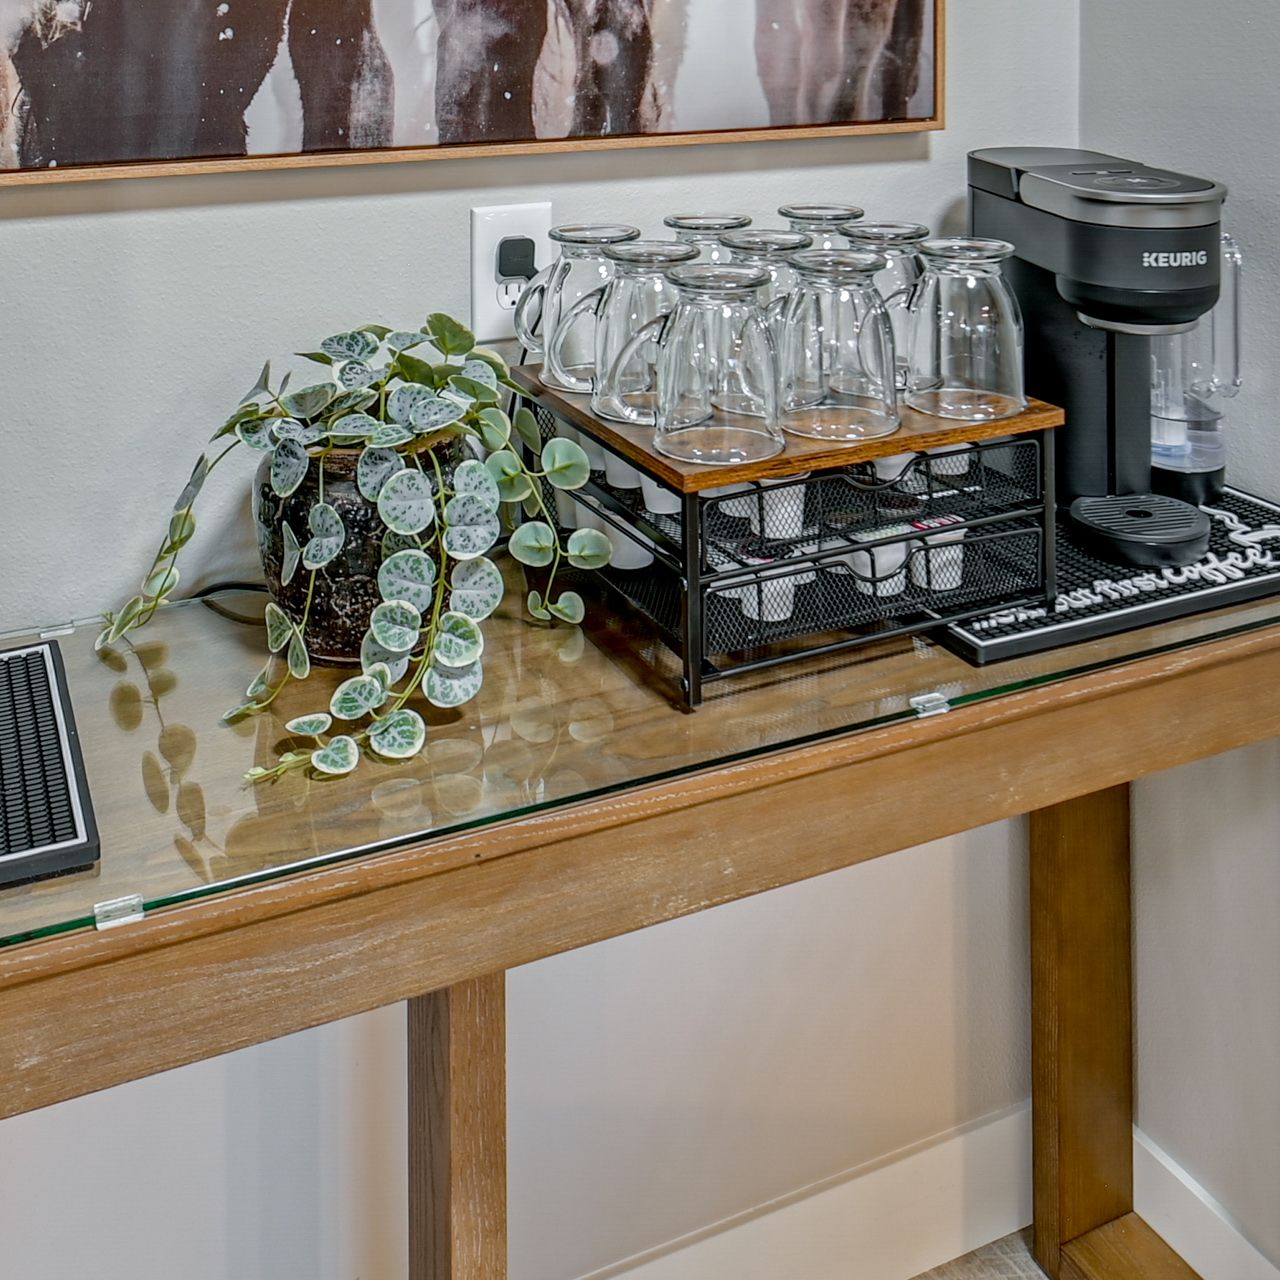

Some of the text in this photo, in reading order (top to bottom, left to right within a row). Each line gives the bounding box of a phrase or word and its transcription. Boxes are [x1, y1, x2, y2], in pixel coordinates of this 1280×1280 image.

[1142, 250, 1208, 267] KEURIG
[1093, 572, 1169, 600] first
[1163, 551, 1272, 584] coffee
